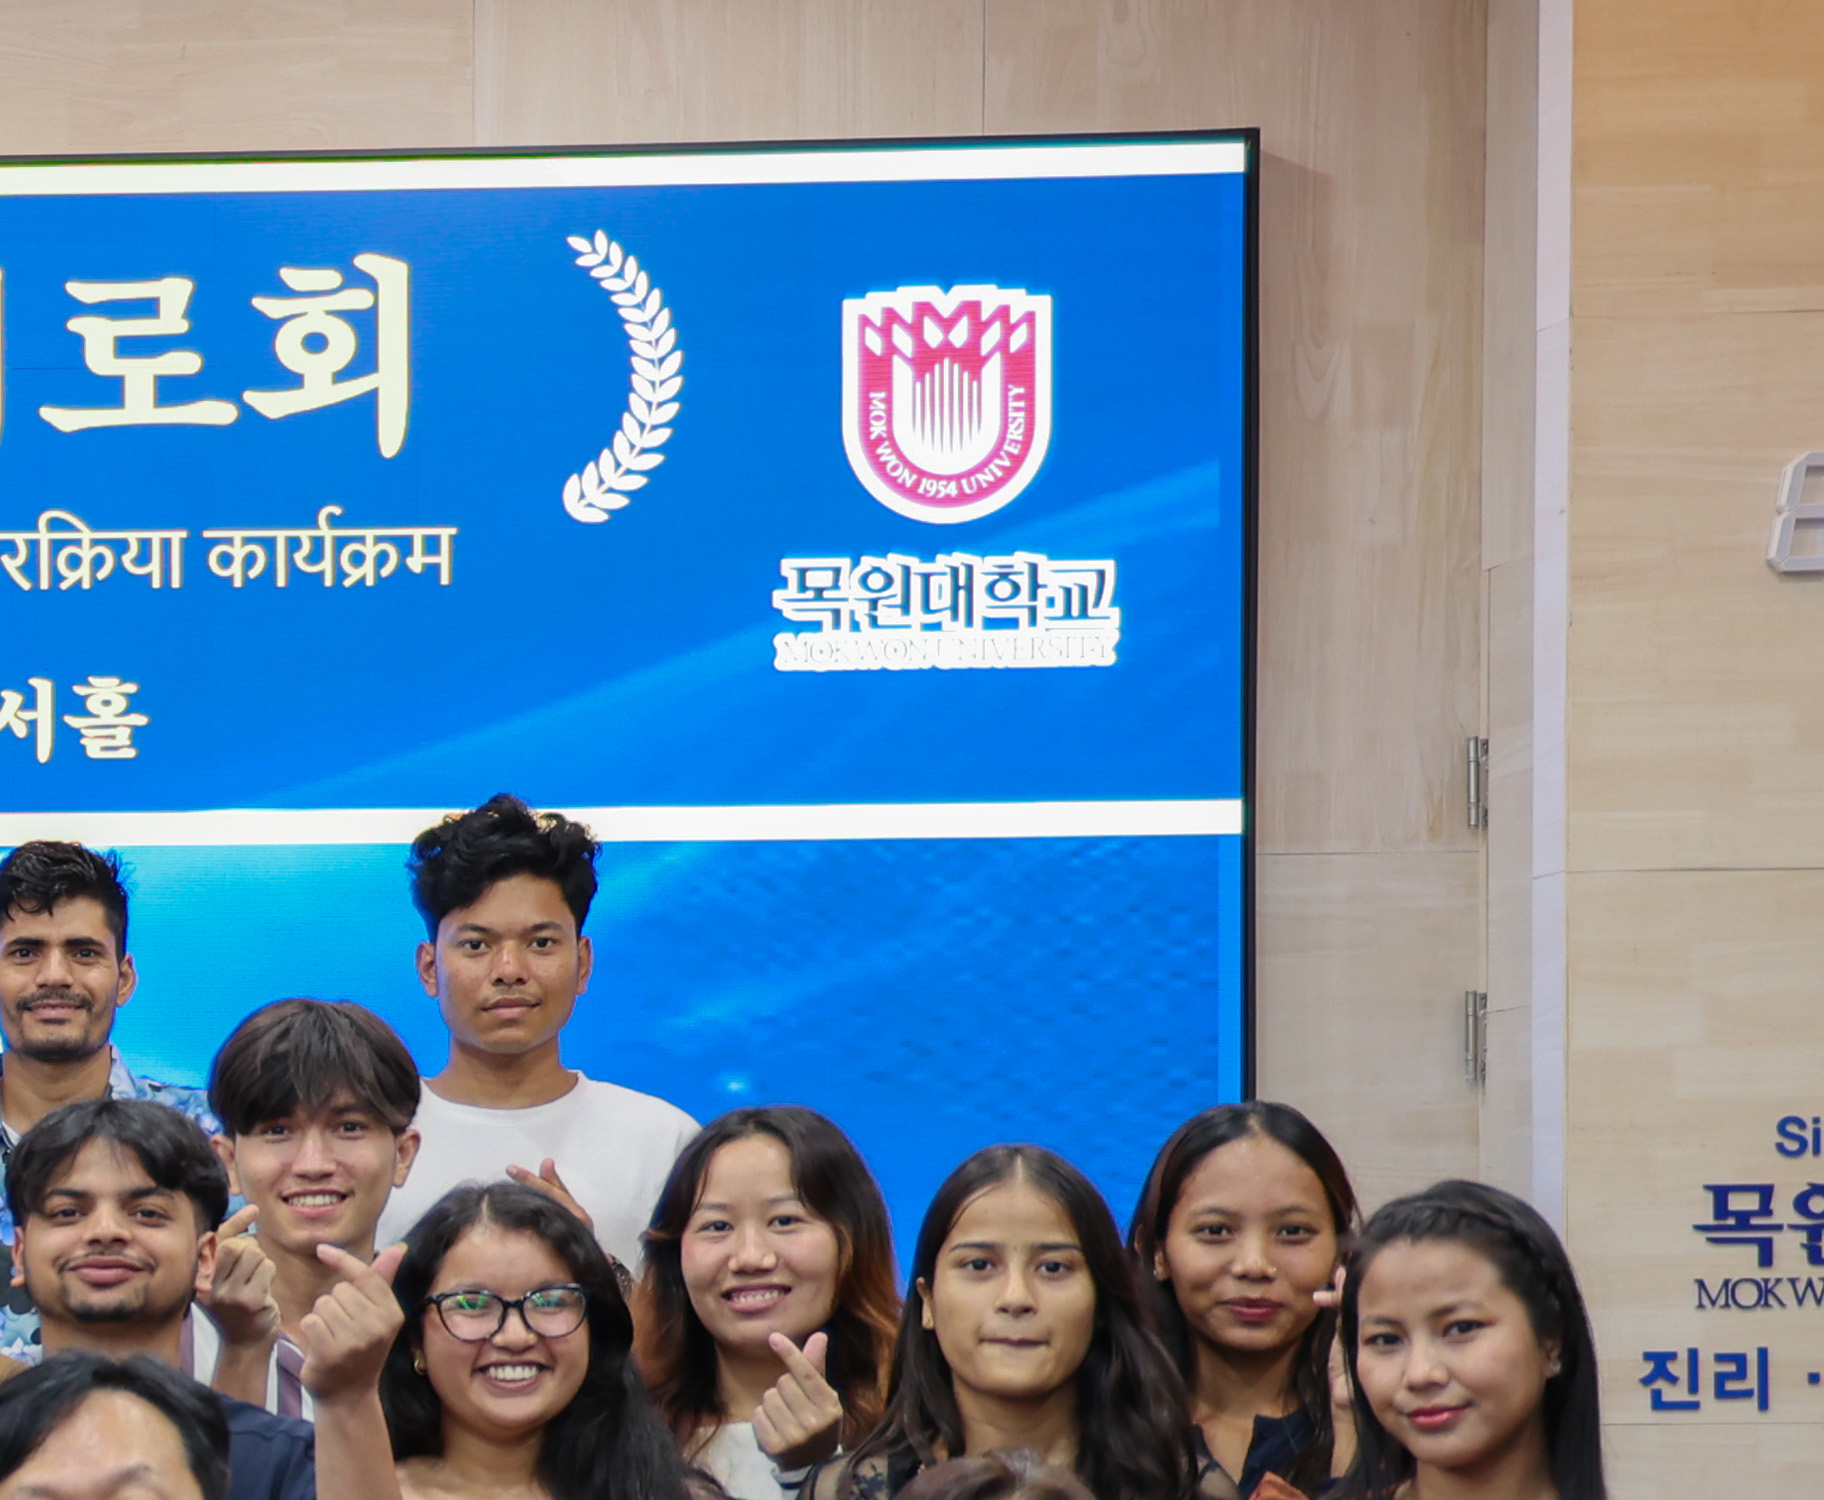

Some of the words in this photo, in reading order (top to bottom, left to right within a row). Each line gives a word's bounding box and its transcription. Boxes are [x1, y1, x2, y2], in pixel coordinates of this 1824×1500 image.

[868, 391, 888, 440] MOK
[961, 384, 1027, 497] UNIVERSITY
[875, 440, 918, 489] WON
[918, 477, 958, 499] 1954
[202, 505, 458, 587] कार्यक्रम
[778, 558, 1115, 632] 목원대학교
[1639, 1346, 1769, 1412] 진리
